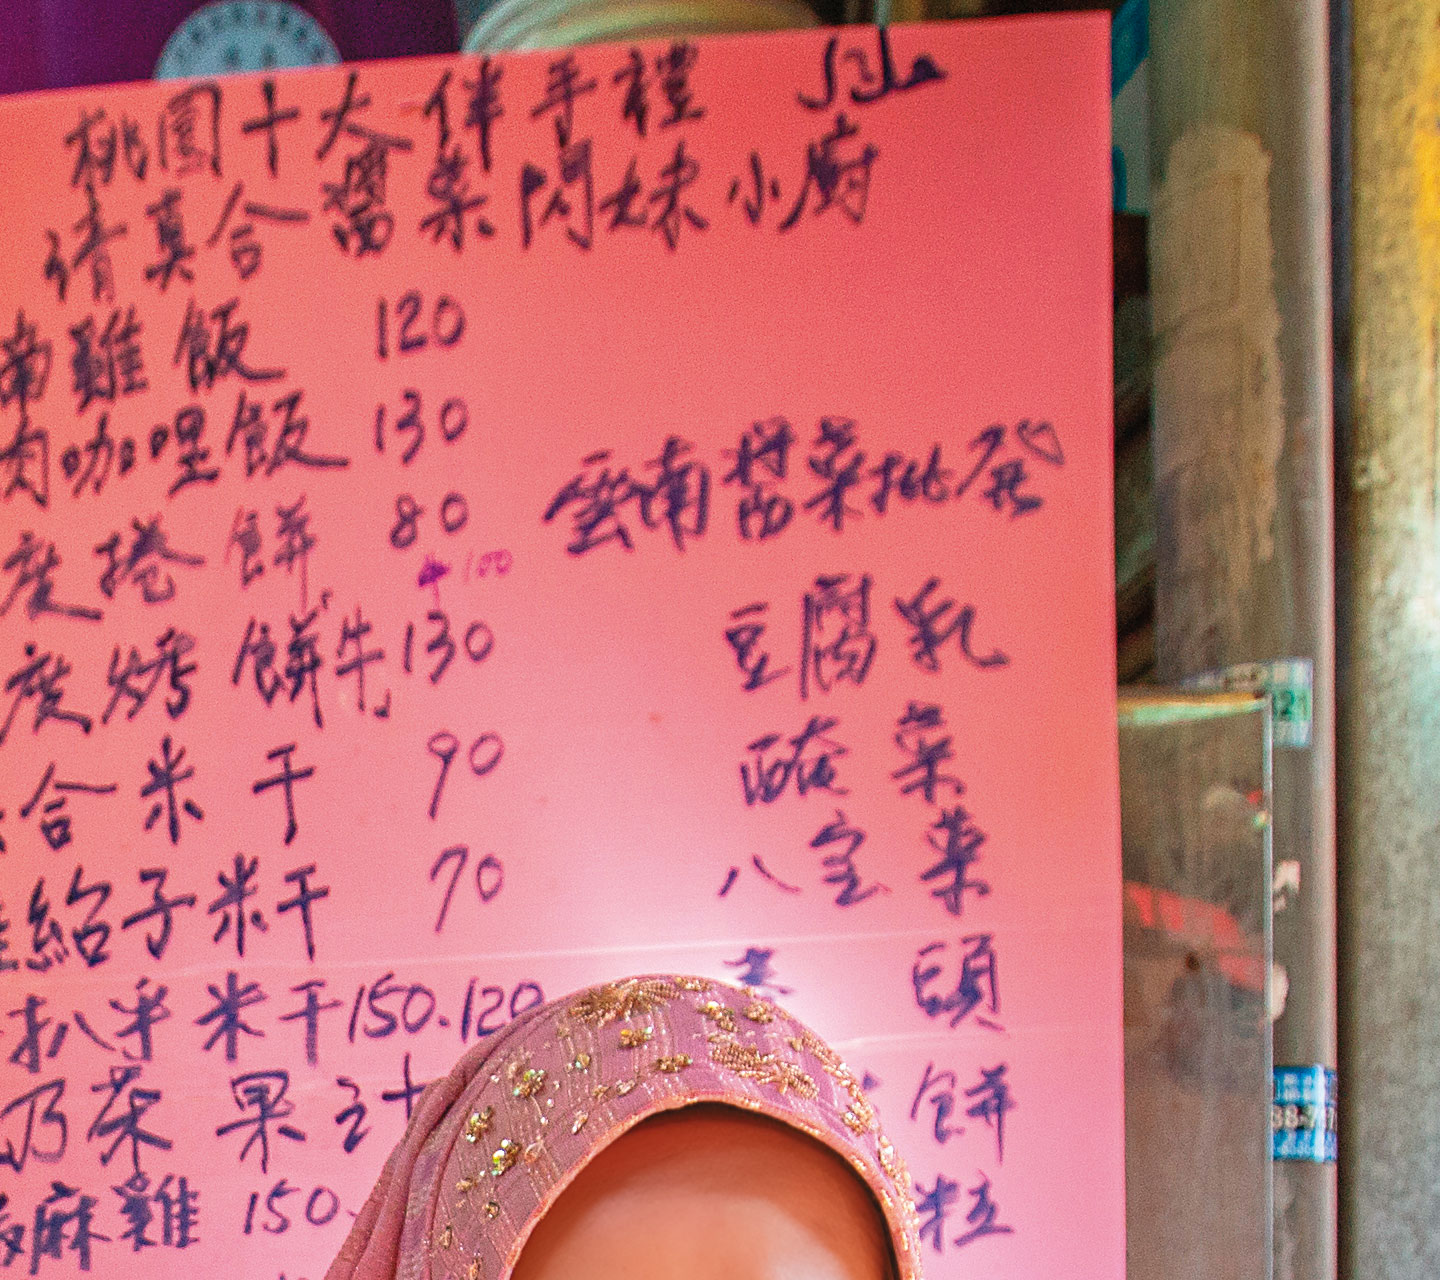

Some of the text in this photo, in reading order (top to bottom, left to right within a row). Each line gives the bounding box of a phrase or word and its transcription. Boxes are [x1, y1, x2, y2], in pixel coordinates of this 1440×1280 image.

[65, 42, 707, 188] 桃園十大伴手禮
[373, 289, 467, 360] 120
[374, 388, 469, 465] 130
[389, 493, 471, 549] 80
[404, 608, 495, 684] 130
[723, 571, 1011, 702] 豆腐乳
[428, 730, 505, 820] 90
[430, 845, 505, 934] 70
